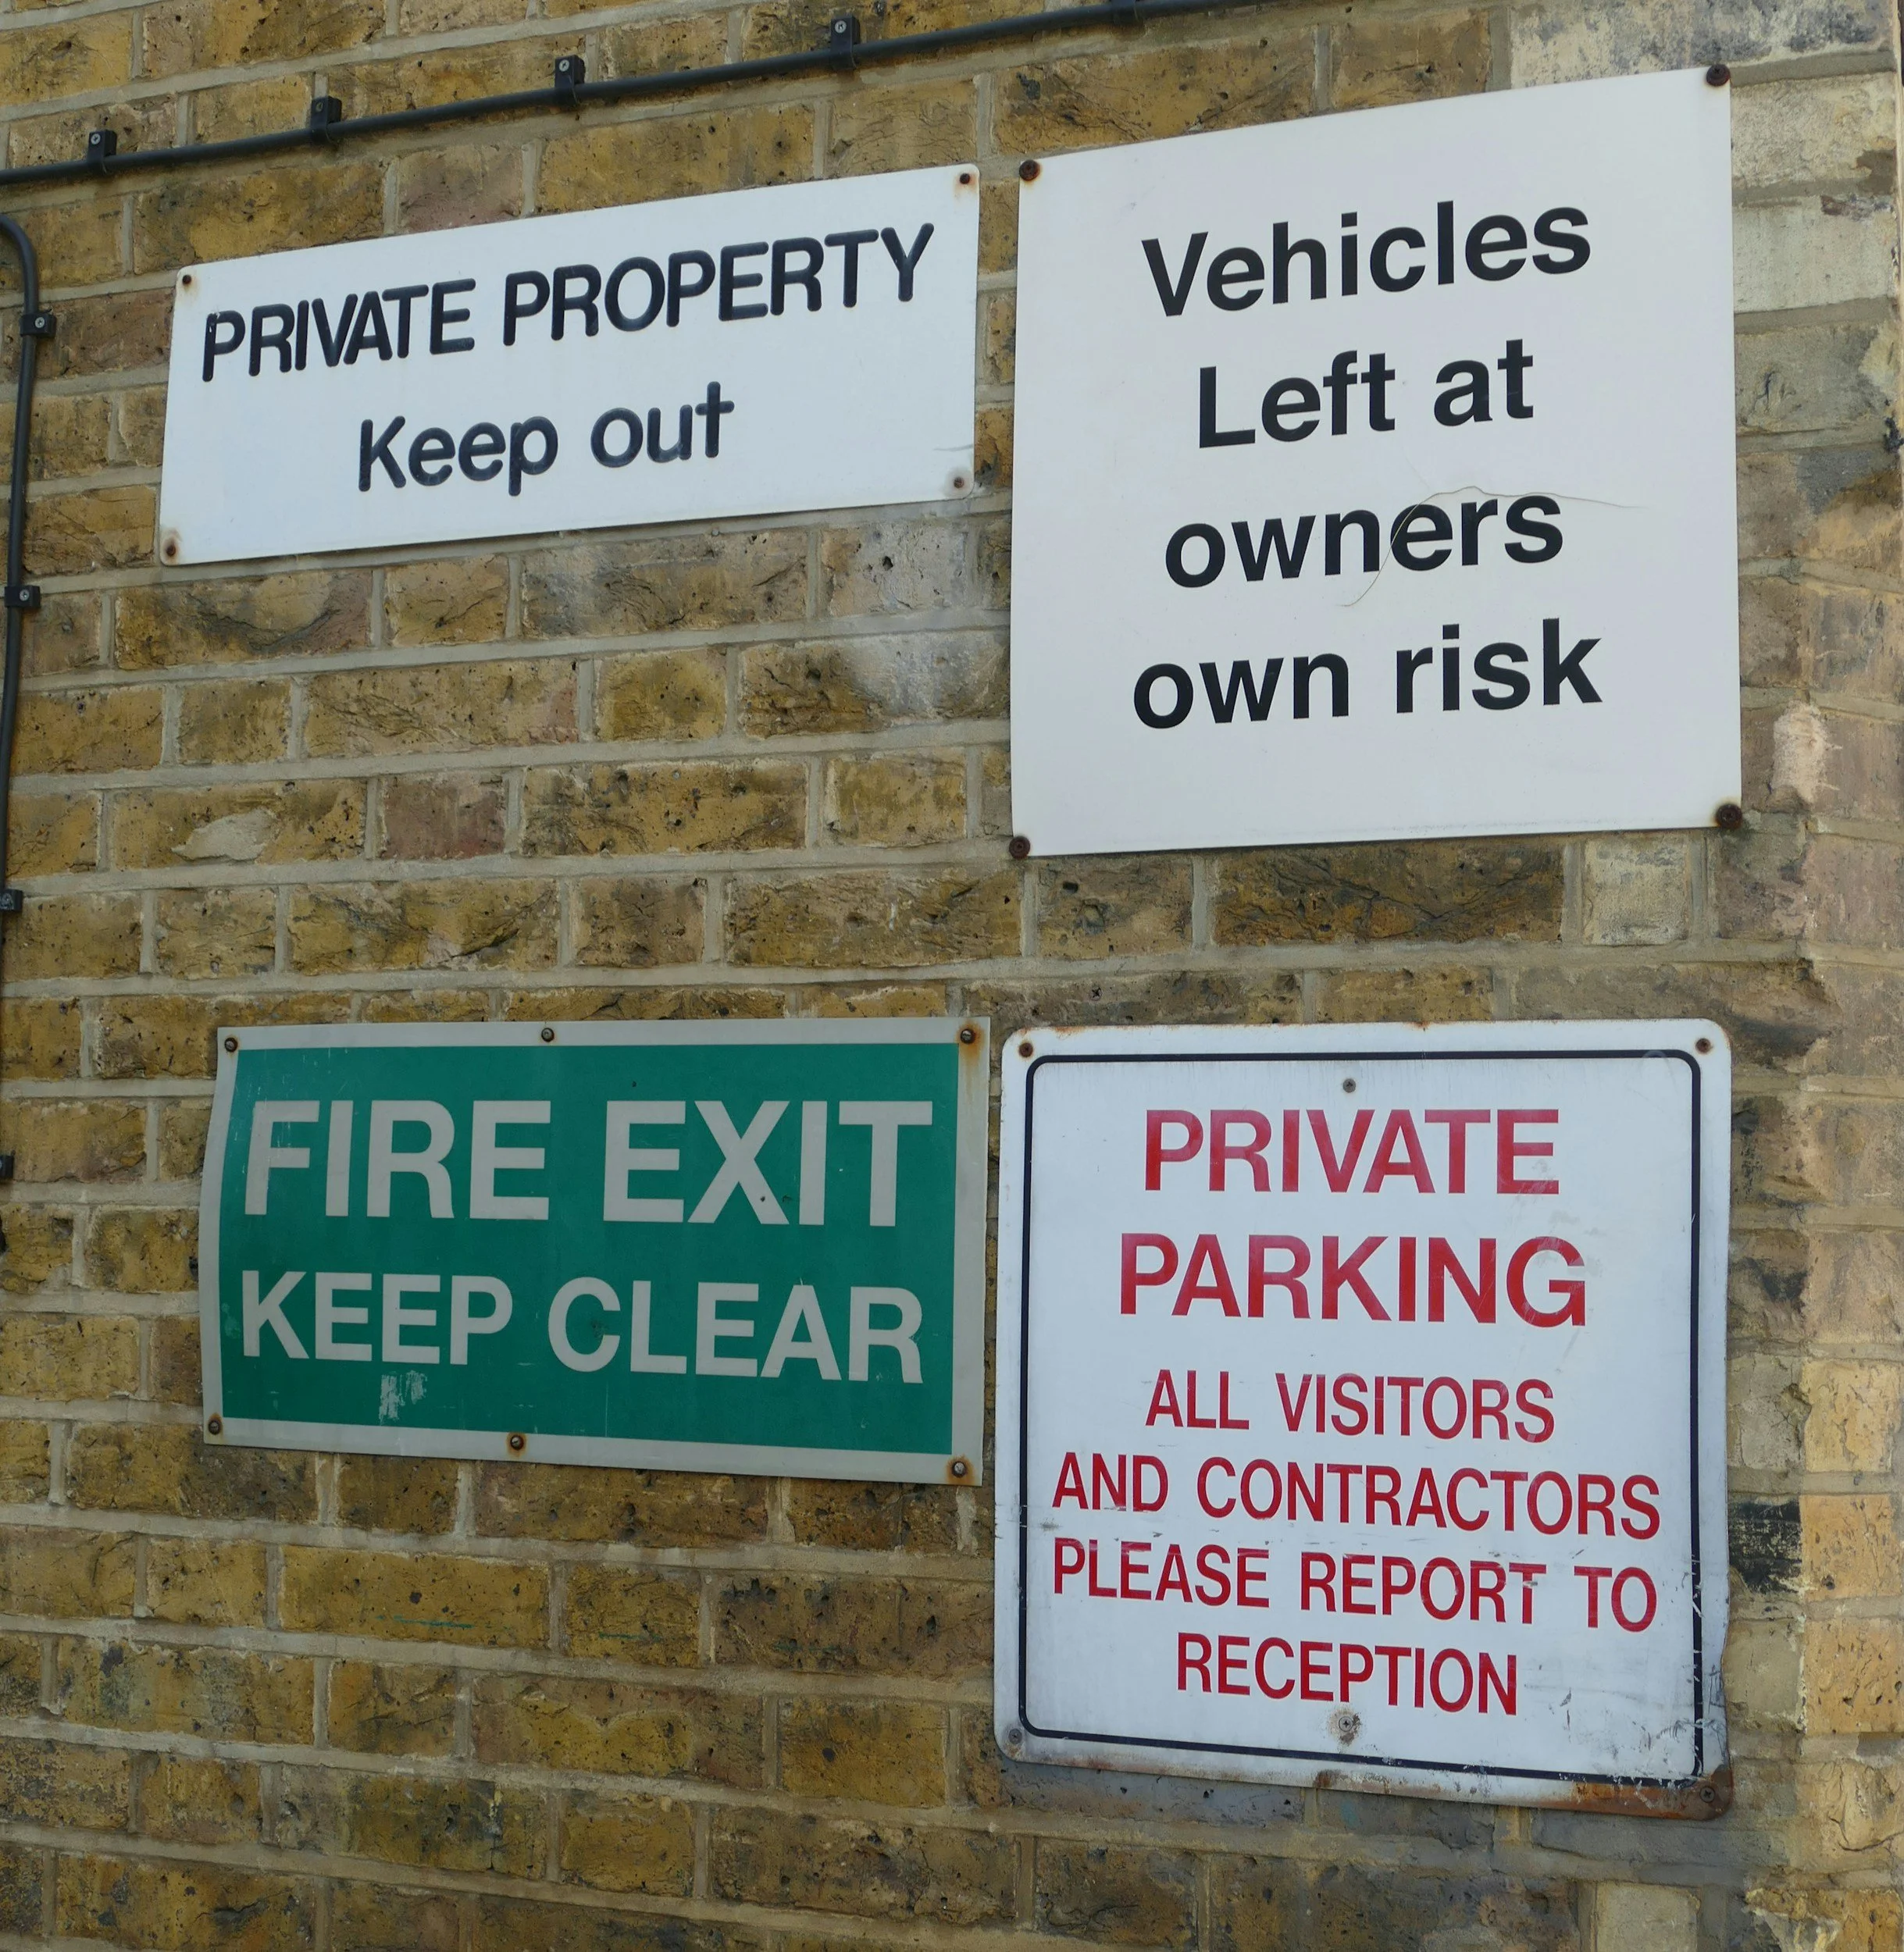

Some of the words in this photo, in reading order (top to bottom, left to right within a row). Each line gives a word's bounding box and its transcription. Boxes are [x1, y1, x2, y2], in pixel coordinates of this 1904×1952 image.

[203, 280, 476, 382] PRIVATE
[504, 224, 934, 346] PROPERTY
[1142, 201, 1590, 316] Vehicles
[359, 417, 558, 496] Keep
[591, 383, 734, 468] out
[1200, 351, 1395, 448] Left
[1435, 340, 1533, 426] at
[1166, 496, 1563, 587] owners
[1134, 654, 1349, 728] own
[1397, 618, 1602, 713] risk
[246, 1101, 550, 1219] FIRE
[604, 1101, 932, 1226] EXIT
[1146, 1110, 1558, 1194] PRIVATE
[244, 1271, 512, 1364] KEEP
[549, 1277, 922, 1383] CLEAR
[1121, 1234, 1585, 1327] PARKING
[1146, 1370, 1249, 1429] ALL
[1277, 1374, 1554, 1443] VISITORS
[1053, 1453, 1168, 1512] AND
[1197, 1458, 1660, 1539] CONTRACTORS
[1054, 1538, 1269, 1608] PLEASE
[1301, 1553, 1546, 1623] REPORT
[1574, 1567, 1656, 1632] TO
[1178, 1633, 1516, 1715] RECEPTION
